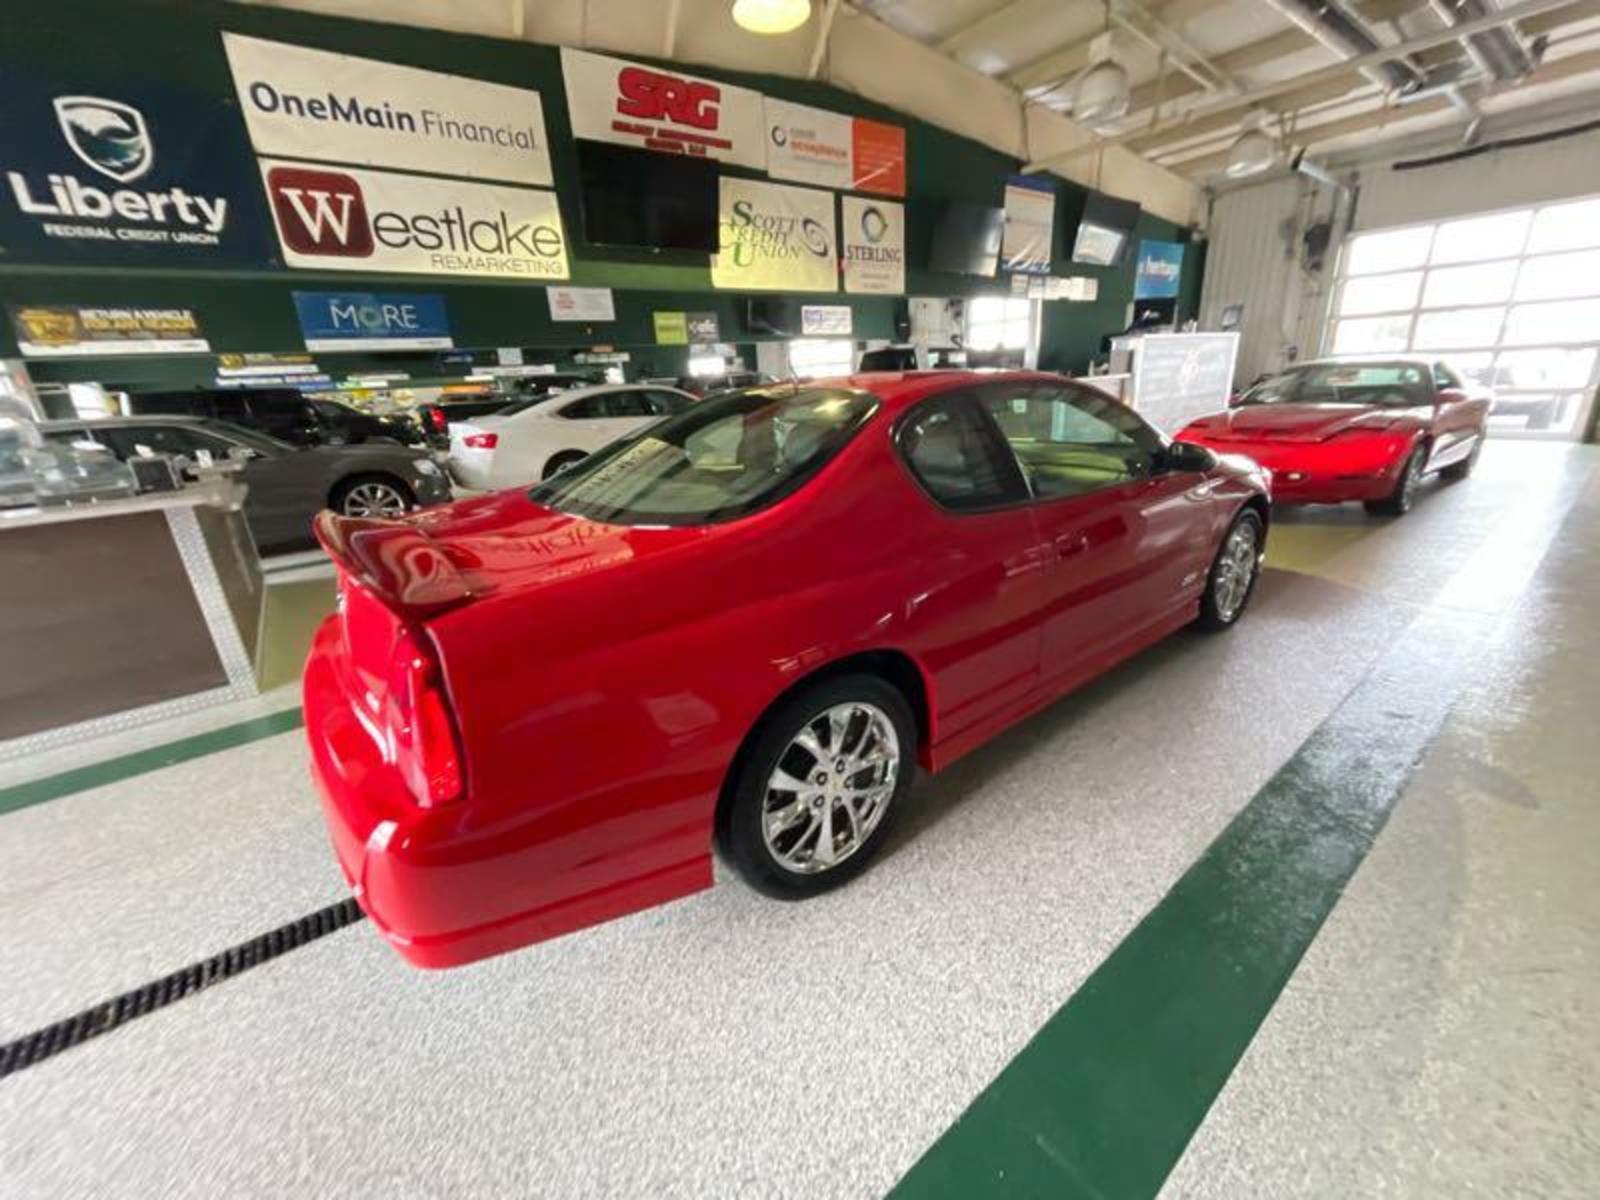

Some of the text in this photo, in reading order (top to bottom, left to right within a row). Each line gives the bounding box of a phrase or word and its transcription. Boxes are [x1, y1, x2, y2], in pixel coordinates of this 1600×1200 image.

[617, 67, 721, 131] SRG
[250, 82, 535, 149] OneMain Financial
[7, 171, 226, 232] Liberty
[43, 223, 219, 245] FEDERAL CREDIT UNION
[279, 187, 562, 257] Westlake
[431, 253, 563, 275] REMARKETING
[733, 241, 801, 268] UNION
[847, 244, 901, 265] STERLING
[328, 303, 420, 329] MORE
